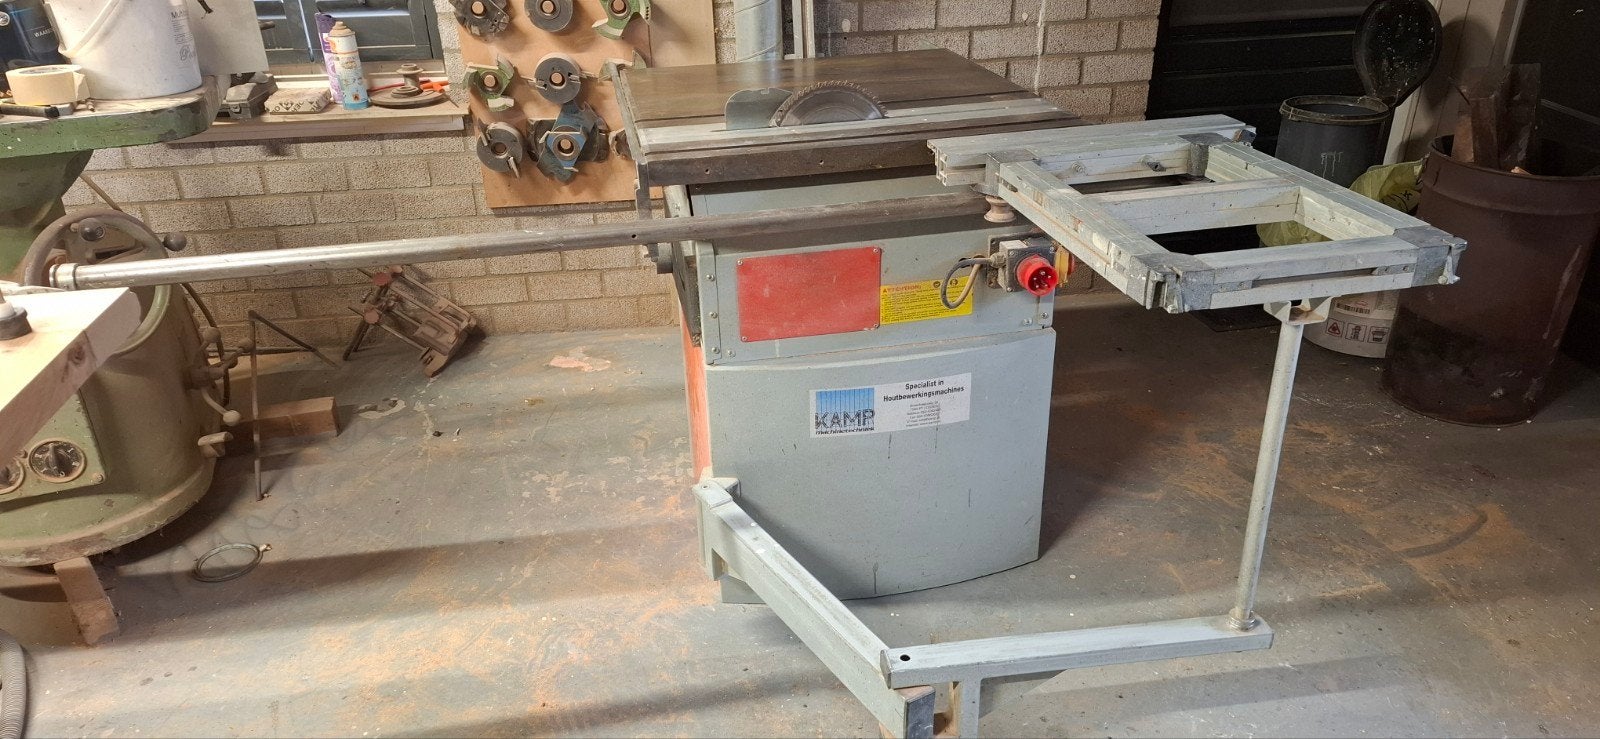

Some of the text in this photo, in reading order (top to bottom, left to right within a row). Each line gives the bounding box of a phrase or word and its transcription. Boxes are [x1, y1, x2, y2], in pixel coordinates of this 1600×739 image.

[905, 380, 937, 391] Specialist
[883, 386, 965, 402] Houtbewerkingsmachines
[815, 409, 875, 430] KAMP
